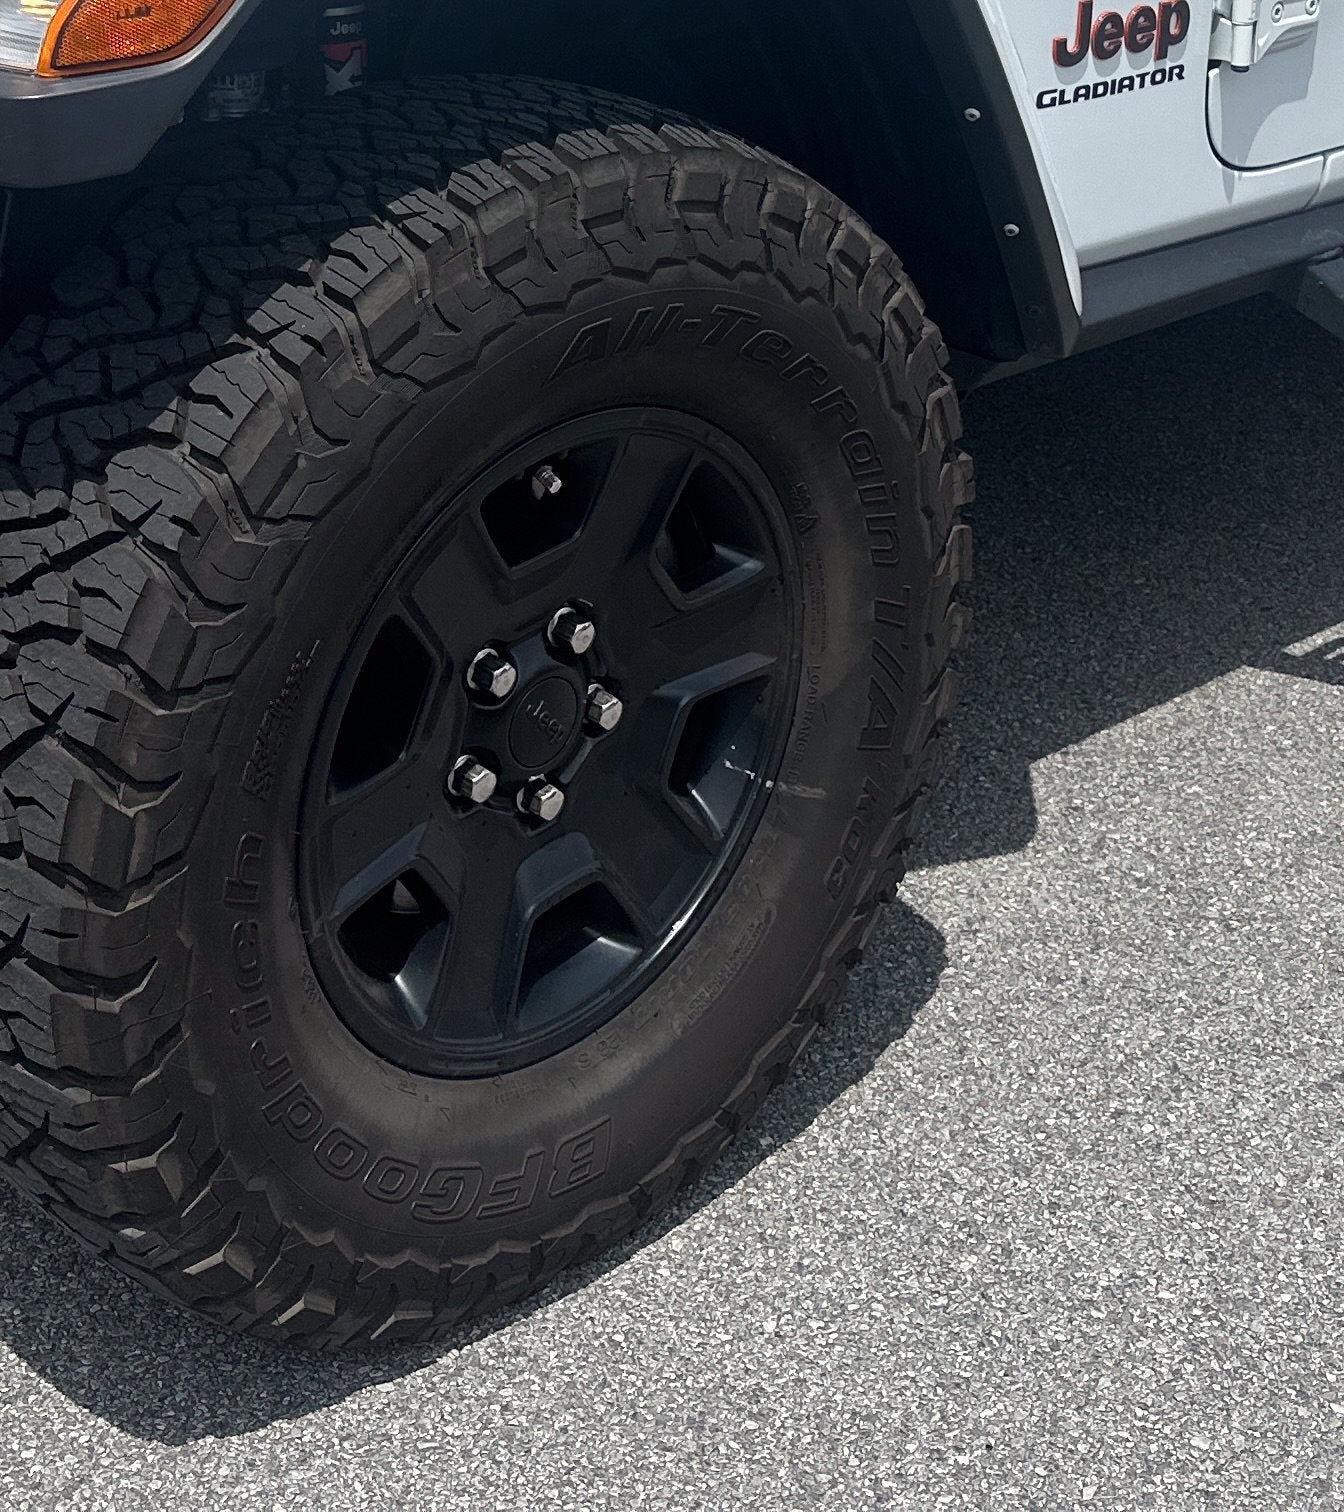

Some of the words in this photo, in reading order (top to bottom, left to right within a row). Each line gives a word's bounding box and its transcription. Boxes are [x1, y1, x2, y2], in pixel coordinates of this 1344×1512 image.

[329, 21, 362, 37] Jeep
[1036, 64, 1185, 109] GLADIATOR
[540, 302, 901, 568] All-Terrain
[526, 699, 565, 745] Jeep
[222, 831, 613, 1225] BFGoodrich
